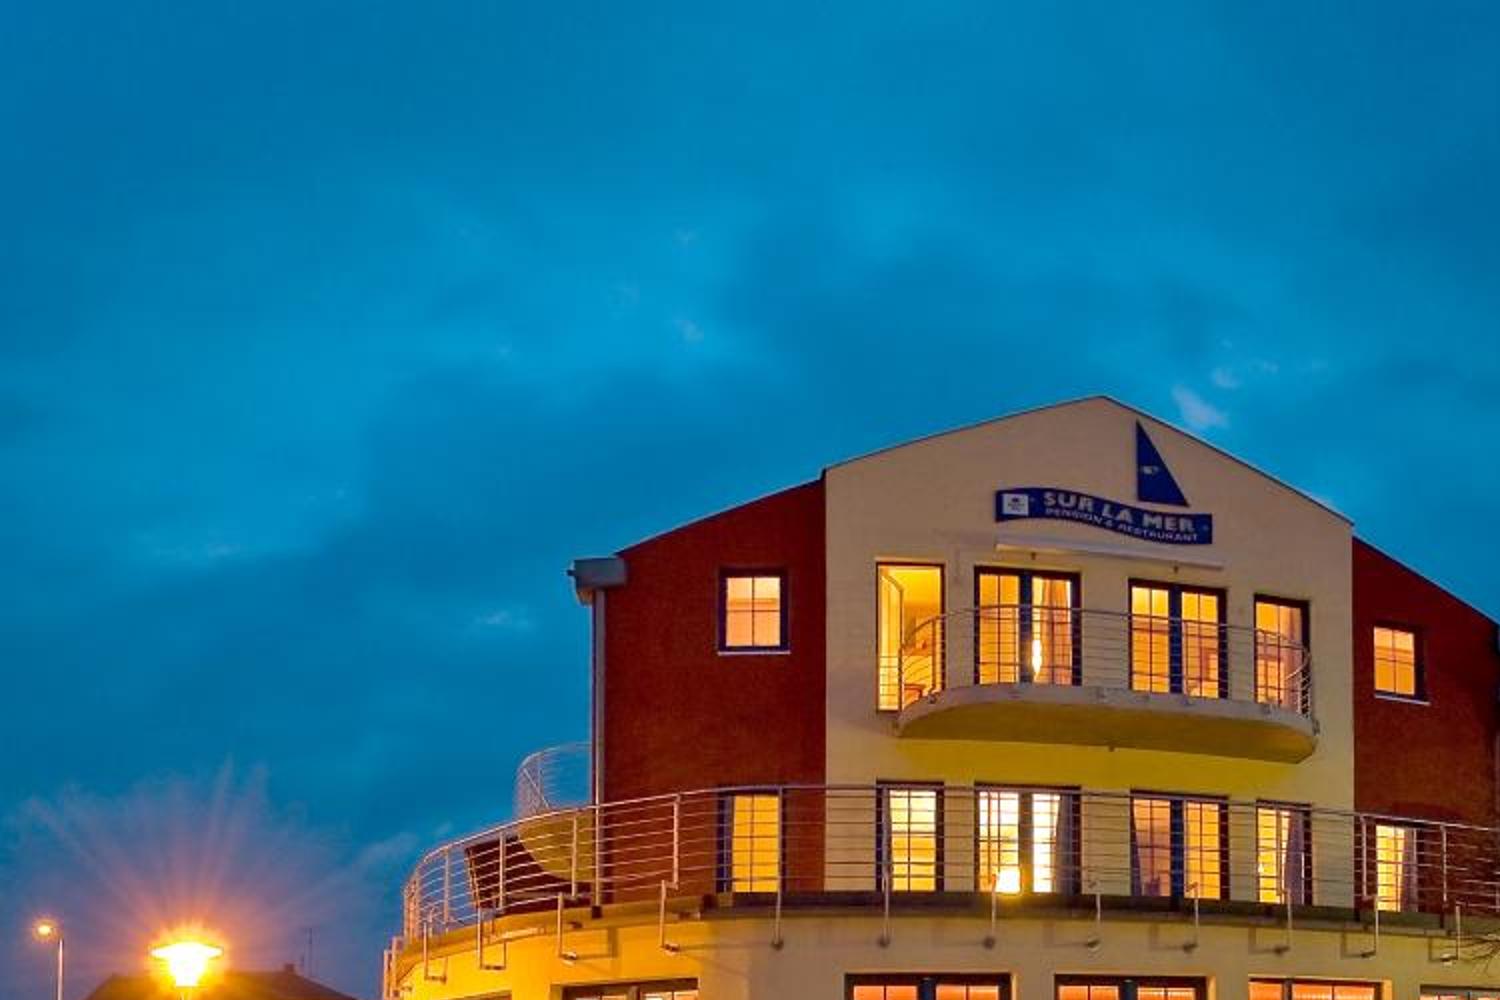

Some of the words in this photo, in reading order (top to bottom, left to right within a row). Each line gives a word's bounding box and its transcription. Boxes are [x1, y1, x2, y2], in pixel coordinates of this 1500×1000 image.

[1043, 491, 1094, 513] SUR
[1102, 503, 1133, 524] LA
[1142, 513, 1195, 534] MER
[1117, 523, 1198, 543] RESTAURANT
